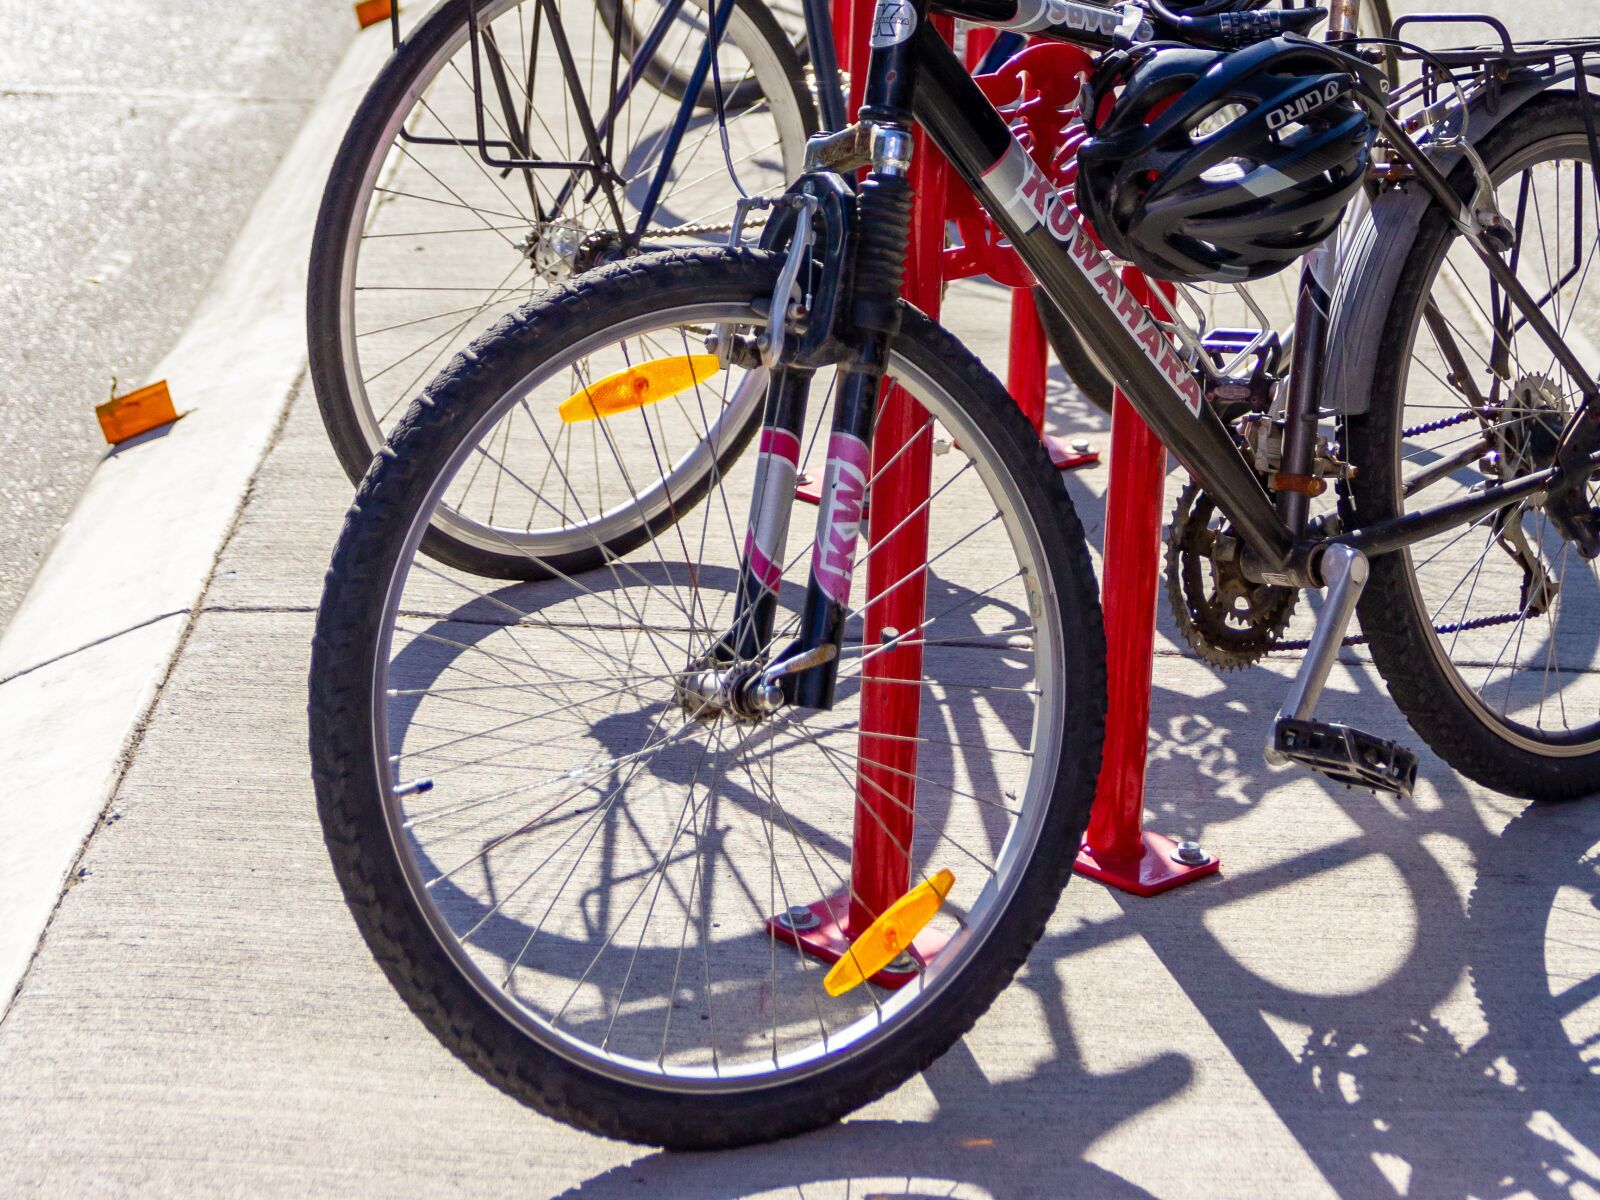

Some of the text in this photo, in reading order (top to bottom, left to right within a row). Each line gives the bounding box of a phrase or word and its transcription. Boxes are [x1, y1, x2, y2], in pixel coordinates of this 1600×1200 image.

[1046, 0, 1154, 42] Savae
[1266, 90, 1322, 129] GIRO
[1015, 162, 1200, 417] KUWAHARA
[822, 461, 866, 575] KW
